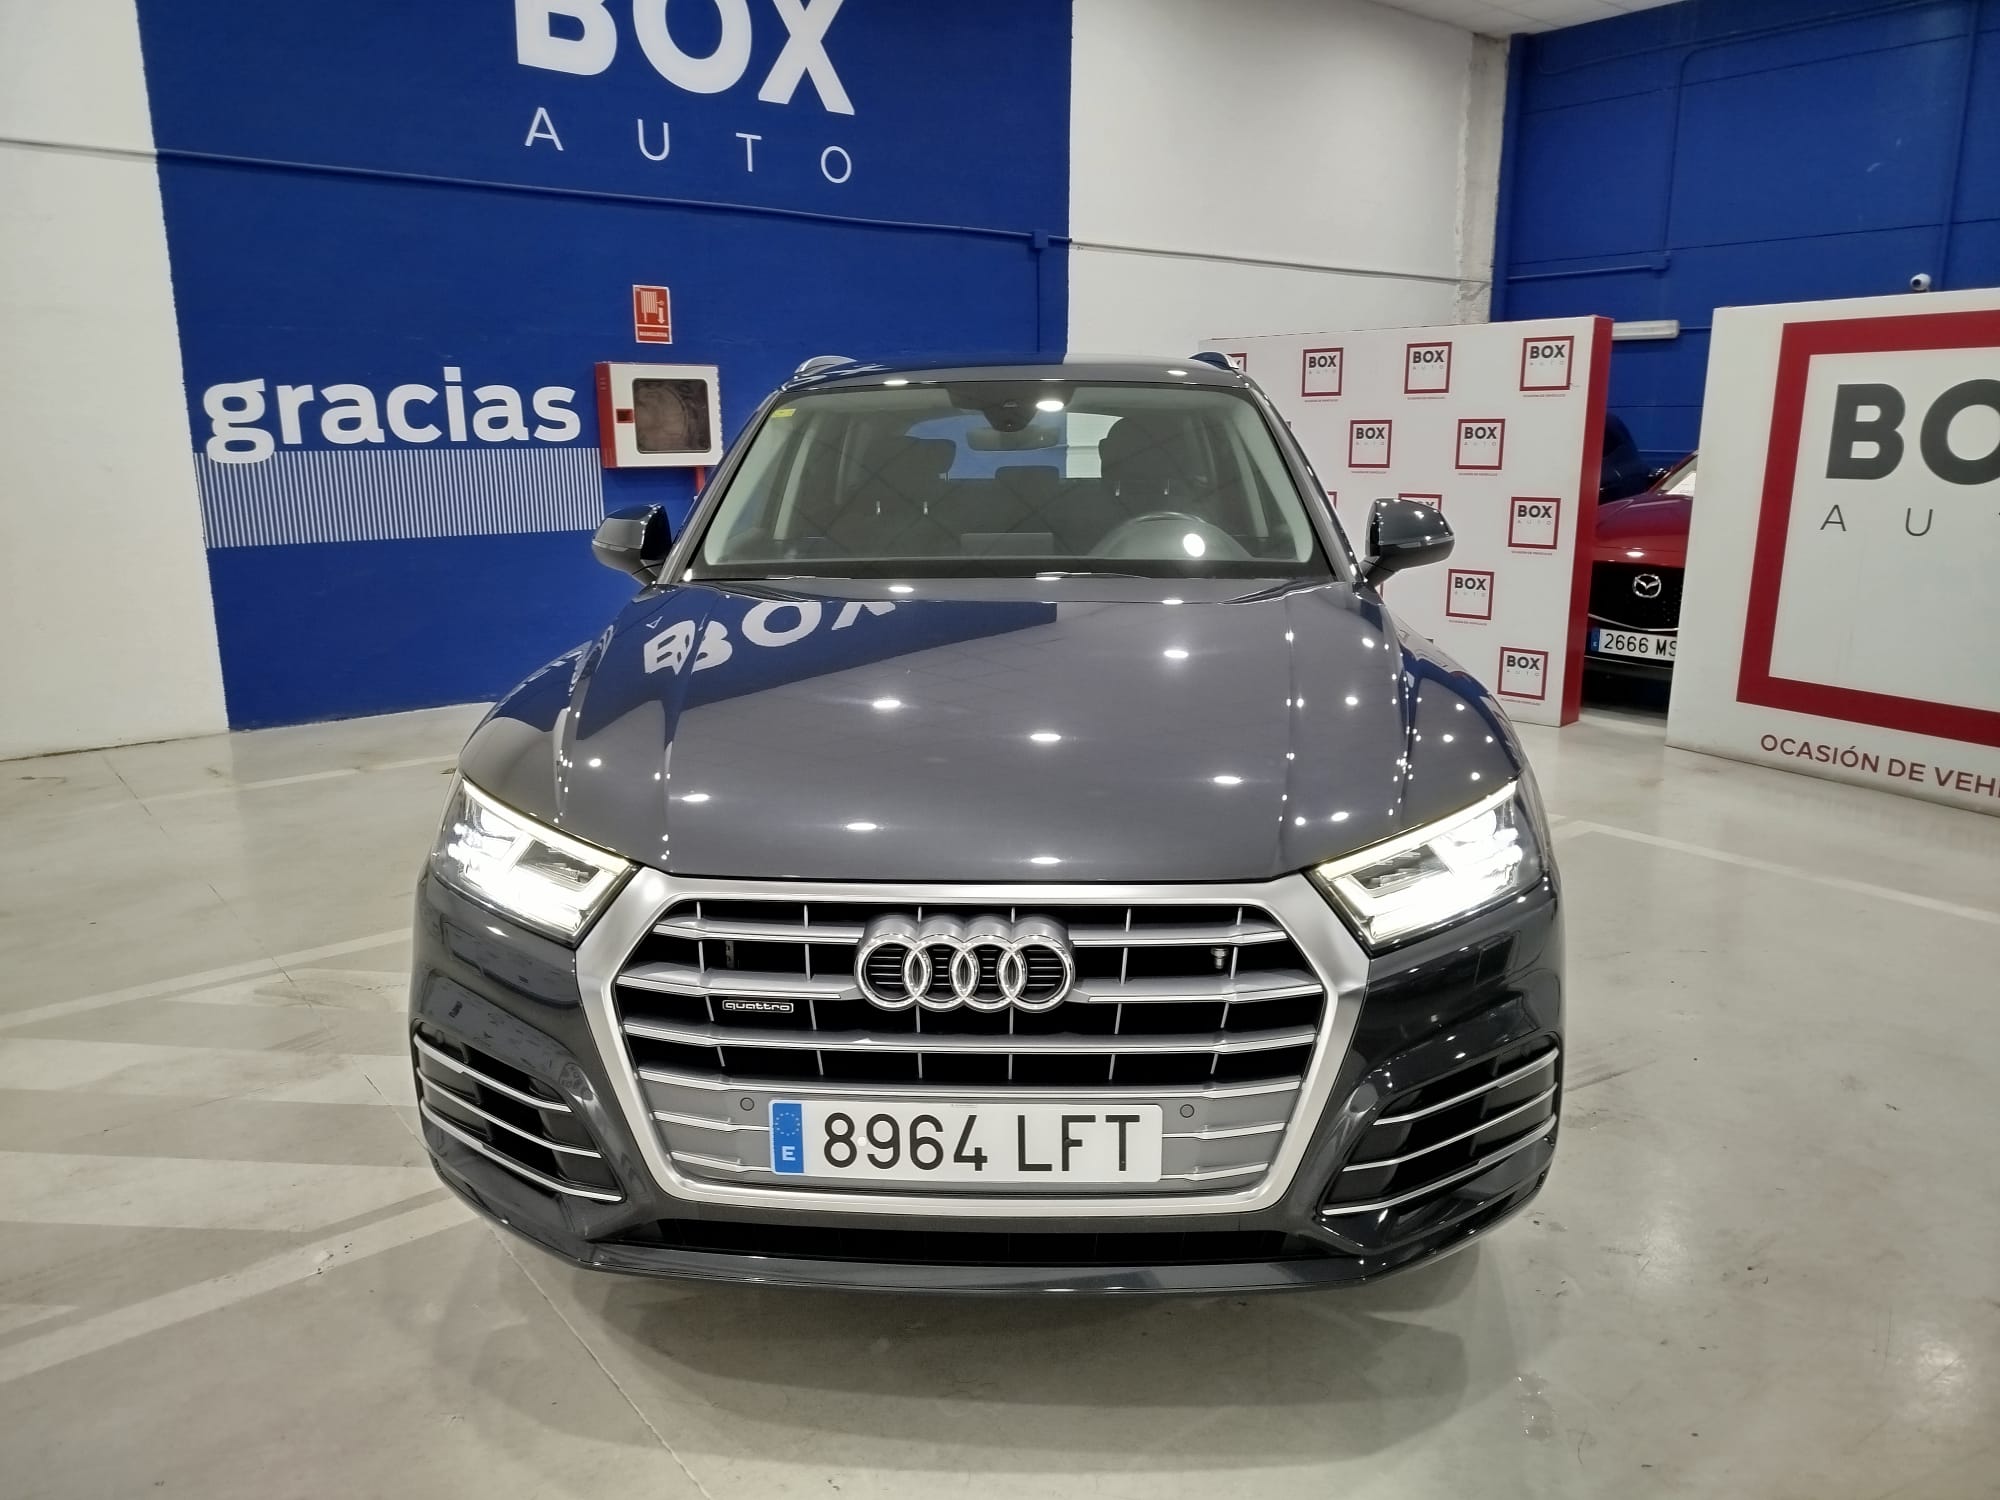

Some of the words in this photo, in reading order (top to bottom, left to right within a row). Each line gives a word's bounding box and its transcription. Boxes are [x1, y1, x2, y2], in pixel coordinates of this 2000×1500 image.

[515, 0, 855, 116] BOX
[523, 106, 853, 185] AUTO
[1412, 350, 1445, 364] BOX
[1529, 344, 1566, 360] BOX
[1308, 355, 1337, 368] BOX
[202, 366, 581, 465] gracias
[1356, 427, 1385, 440] BOX
[1464, 426, 1497, 440] BOX
[1517, 504, 1553, 519] BOX
[1454, 576, 1487, 591] BOX
[1604, 633, 1649, 654] 2666
[1506, 655, 1540, 671] BOX
[1760, 734, 1880, 774] OCASIÓN
[1887, 758, 1926, 783] DE
[1934, 766, 2000, 799] VEH
[725, 1002, 790, 1011] quattro
[823, 1112, 988, 1172] 8964
[1016, 1114, 1141, 1172] LFT
[781, 1145, 796, 1161] E
